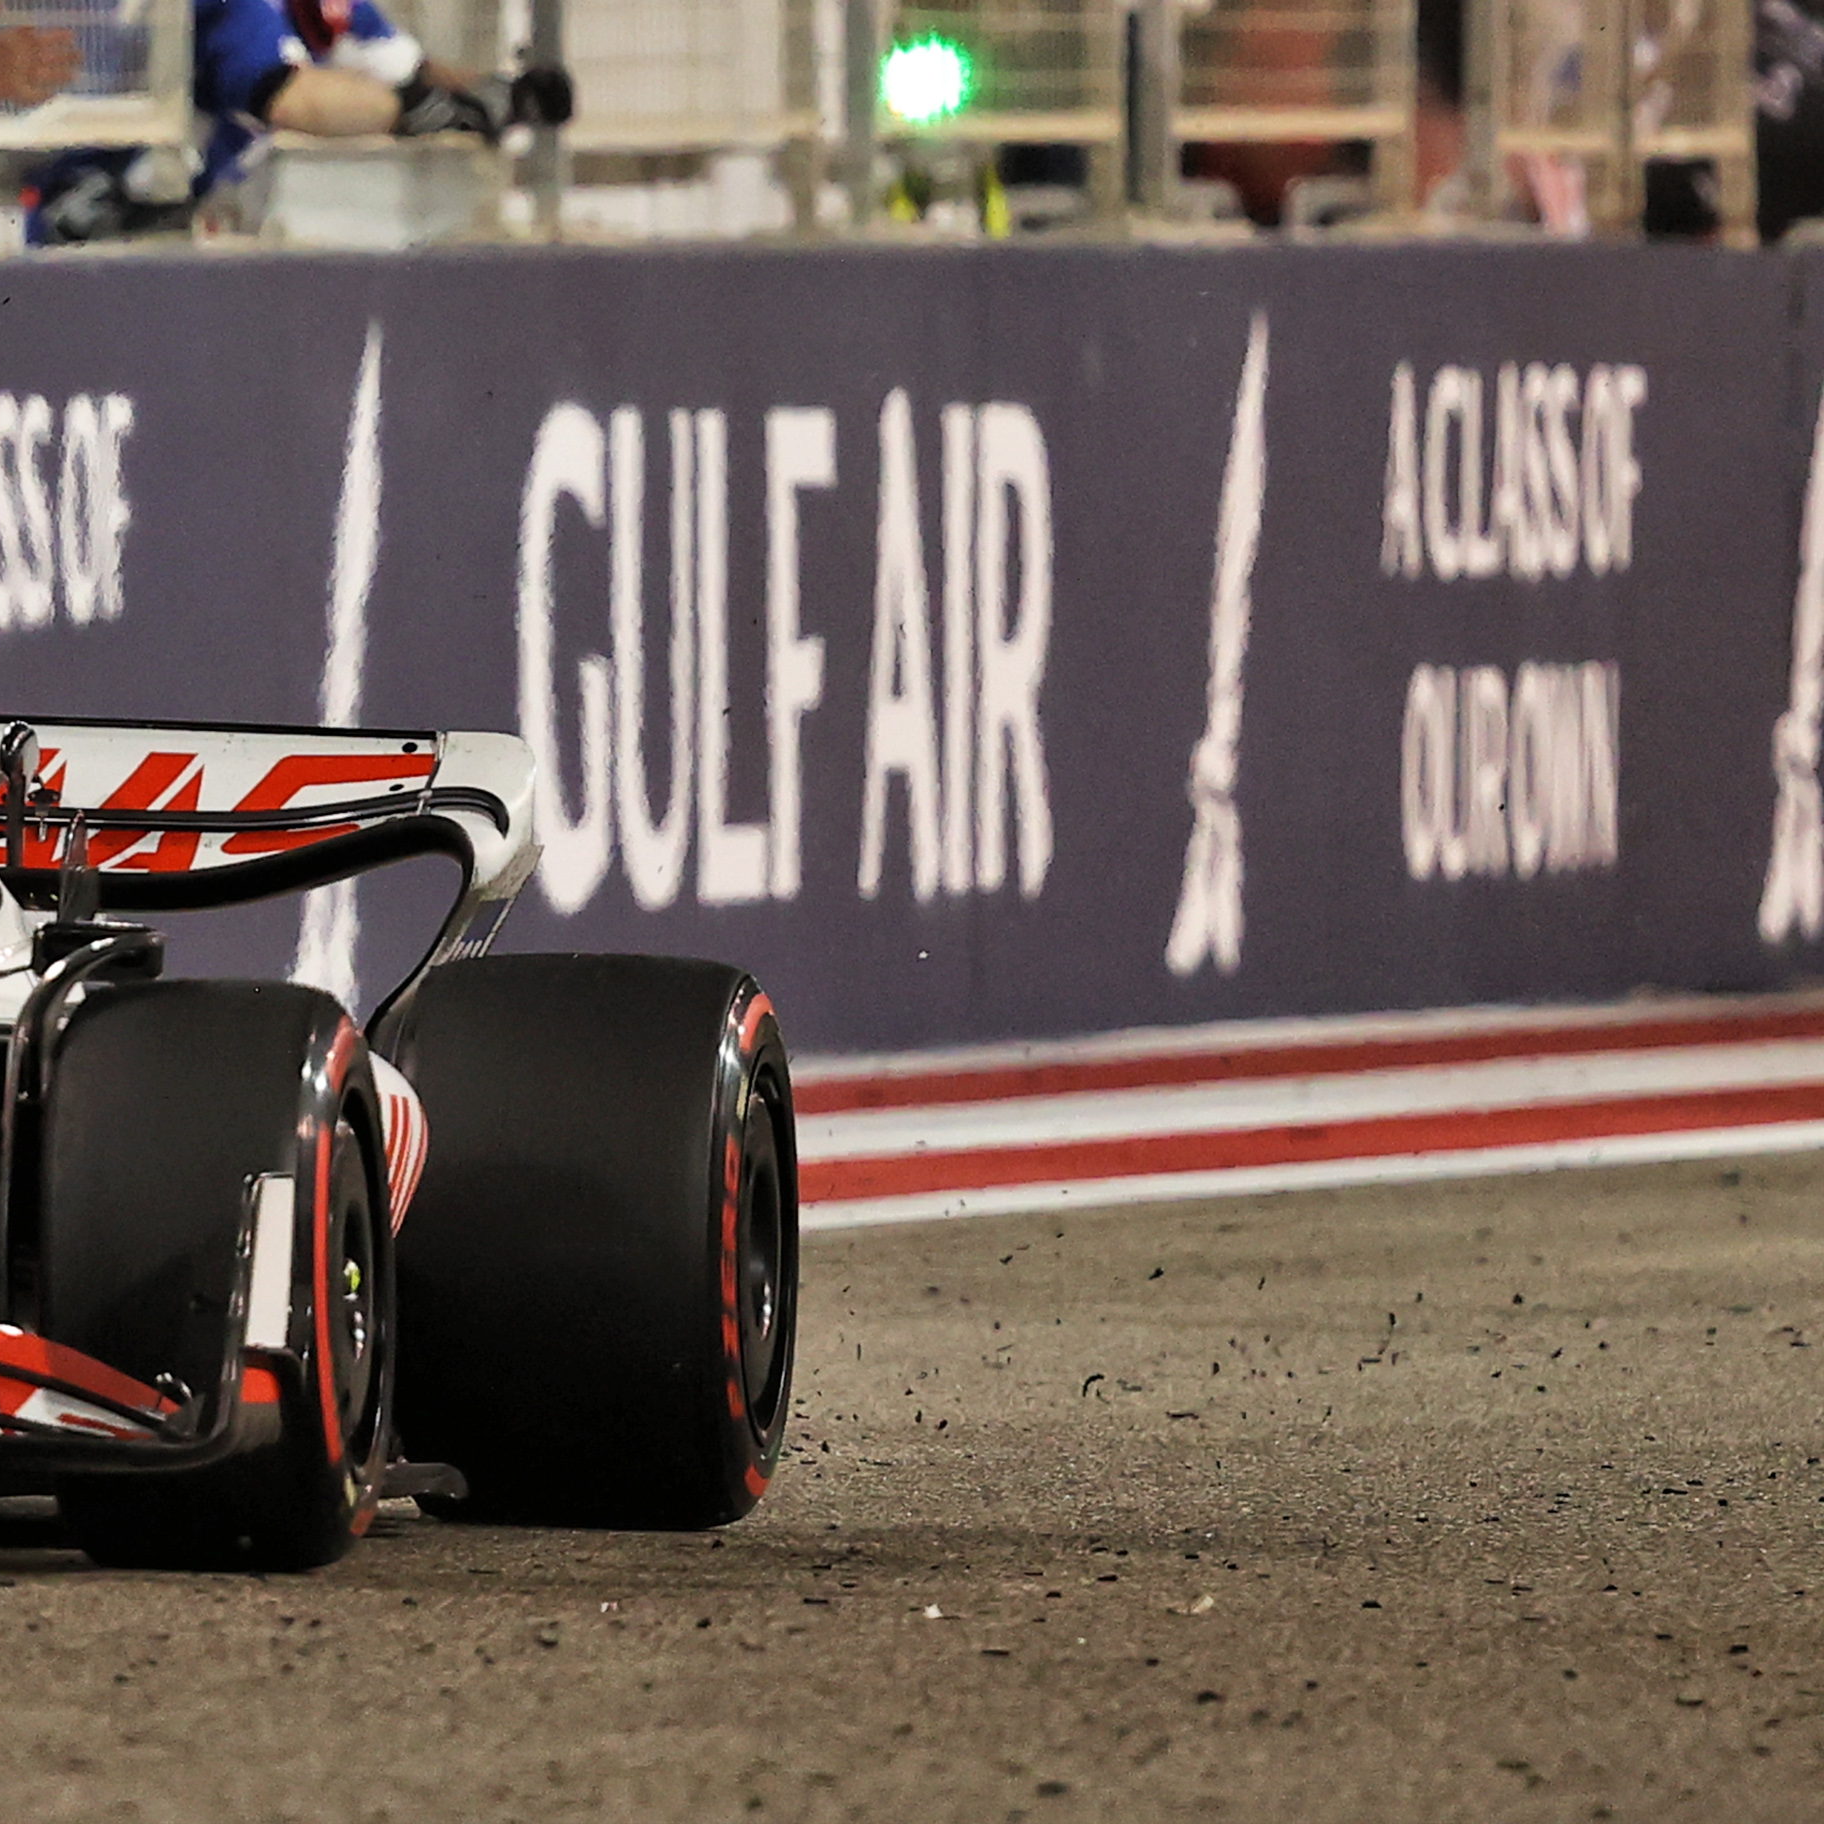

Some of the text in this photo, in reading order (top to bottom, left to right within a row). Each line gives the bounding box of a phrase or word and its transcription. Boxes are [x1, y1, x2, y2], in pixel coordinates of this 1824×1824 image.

[57, 391, 135, 626] OF
[1381, 363, 1646, 579] A CLASS OF
[517, 387, 1054, 916] GULF AIR
[1401, 663, 1509, 879] OUR
